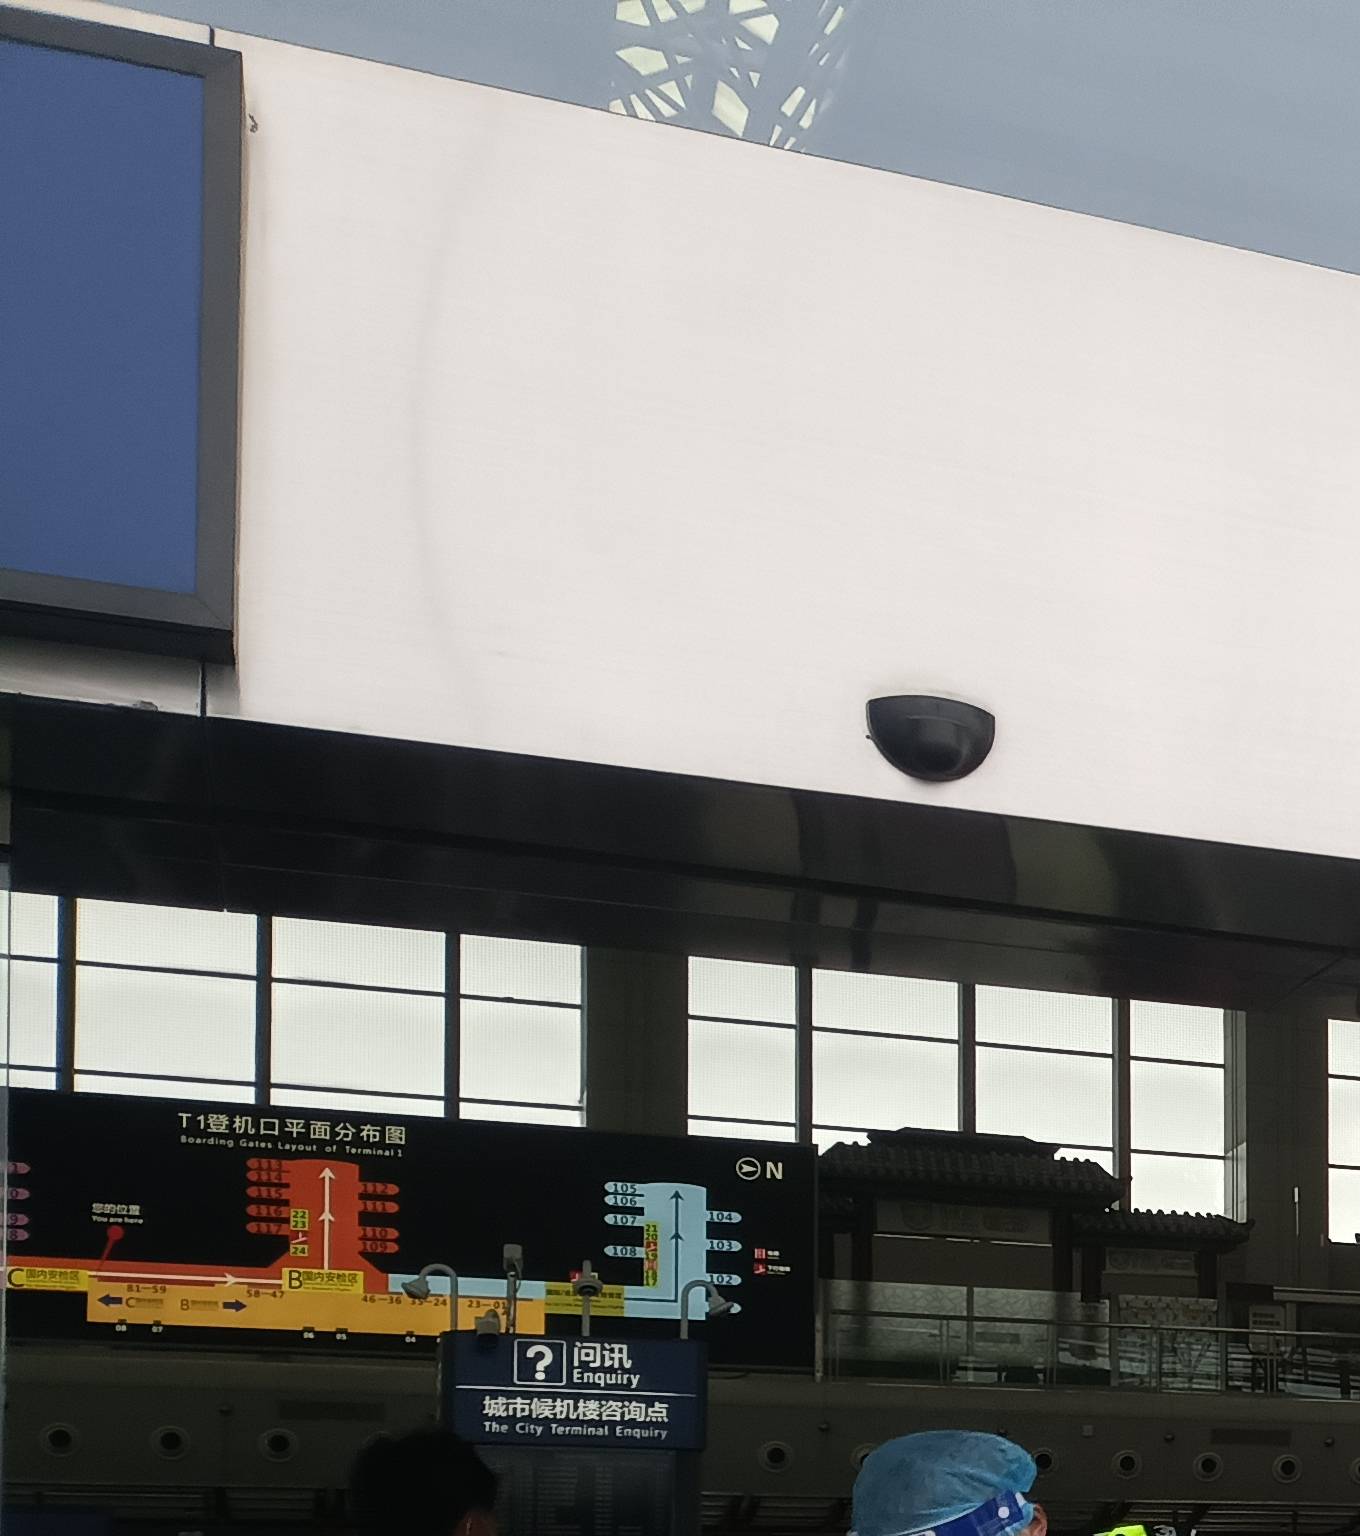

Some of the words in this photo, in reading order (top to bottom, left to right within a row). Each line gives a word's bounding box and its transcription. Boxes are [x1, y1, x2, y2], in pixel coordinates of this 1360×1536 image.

[180, 1135, 234, 1148] Boarding
[240, 1138, 273, 1149] Gates
[278, 1141, 317, 1152] Layout
[325, 1145, 337, 1153] of
[345, 1145, 395, 1157] Terminal
[766, 1161, 783, 1180] N
[362, 1183, 388, 1193] 112
[612, 1183, 637, 1193] 105
[612, 1196, 637, 1206] 106
[362, 1202, 387, 1212] 111
[612, 1215, 637, 1226] 107
[709, 1212, 733, 1222] 104
[362, 1228, 388, 1238] 110
[709, 1240, 732, 1251] 103
[612, 1246, 637, 1257] 108
[288, 1270, 302, 1289] B
[709, 1274, 732, 1285] 102
[573, 1341, 633, 1369] 问讯
[572, 1369, 640, 1388] Enquiry
[482, 1396, 669, 1423] 城市候机楼咨询点
[484, 1421, 508, 1433] The
[516, 1423, 543, 1437] City
[551, 1424, 609, 1437] Terminal
[616, 1426, 668, 1440] Enquiry
